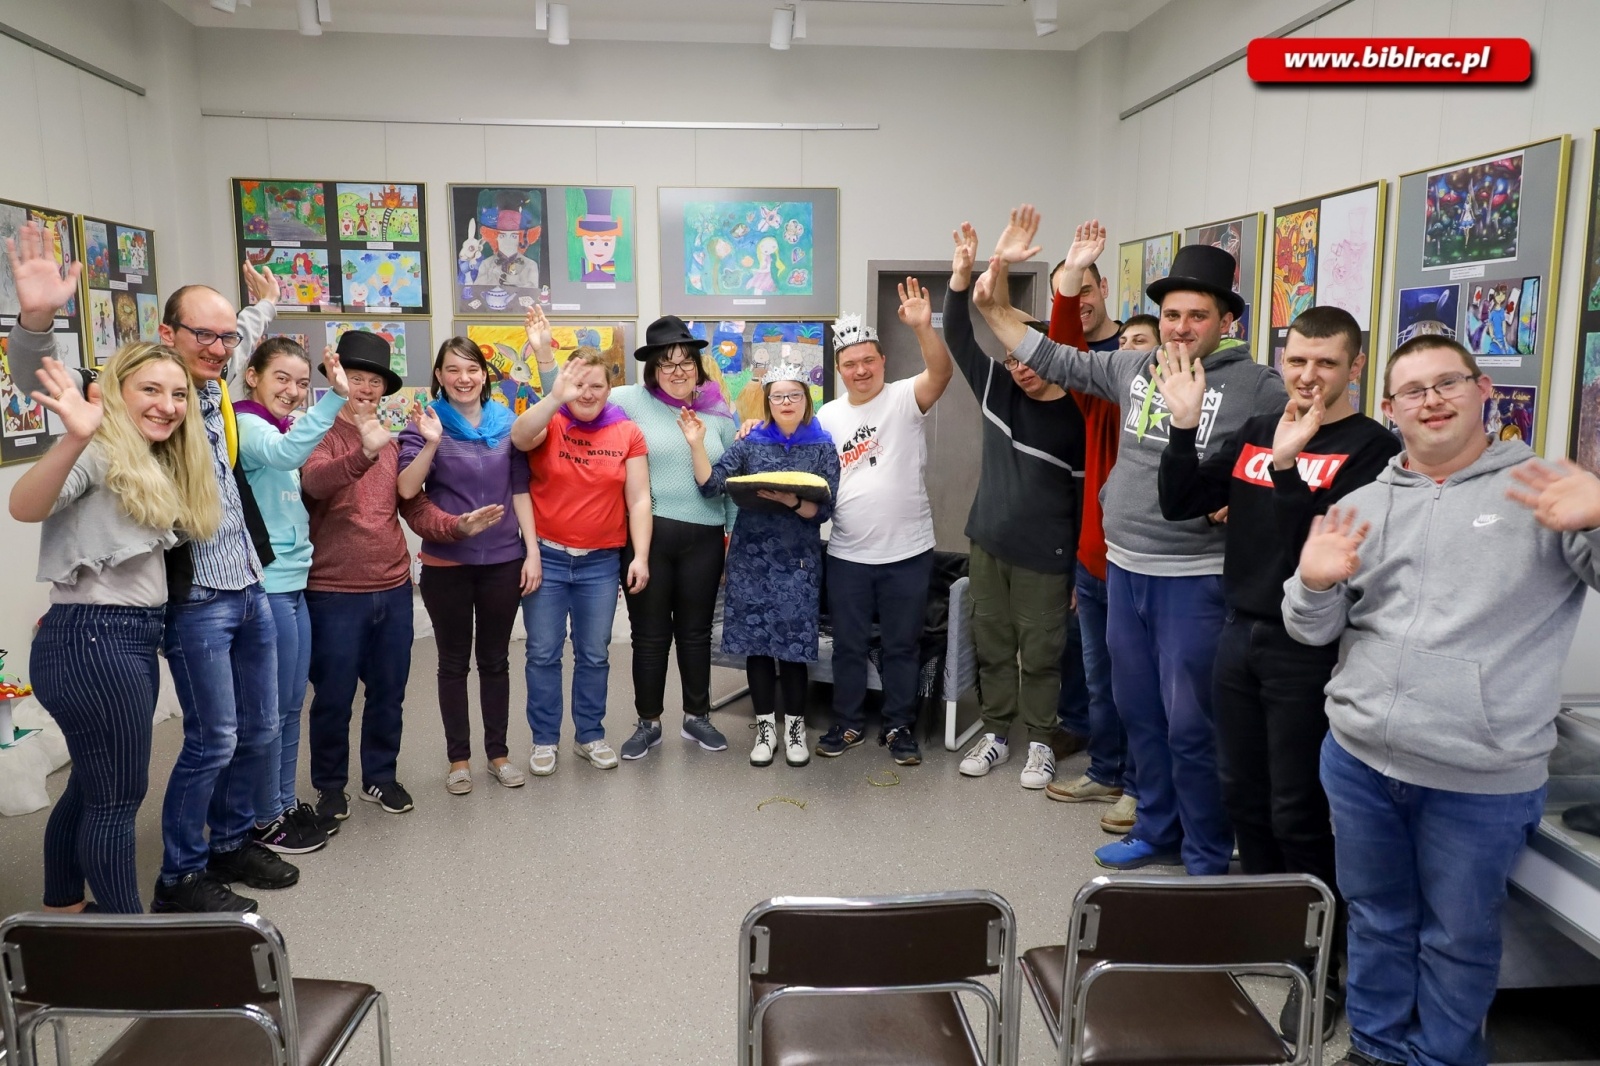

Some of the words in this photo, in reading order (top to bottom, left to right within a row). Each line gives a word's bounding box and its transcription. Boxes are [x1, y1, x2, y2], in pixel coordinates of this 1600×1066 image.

[558, 450, 590, 466] DRNK
[587, 449, 624, 457] MONEY
[1477, 513, 1498, 523] NIKE
[273, 832, 287, 845] FILA
